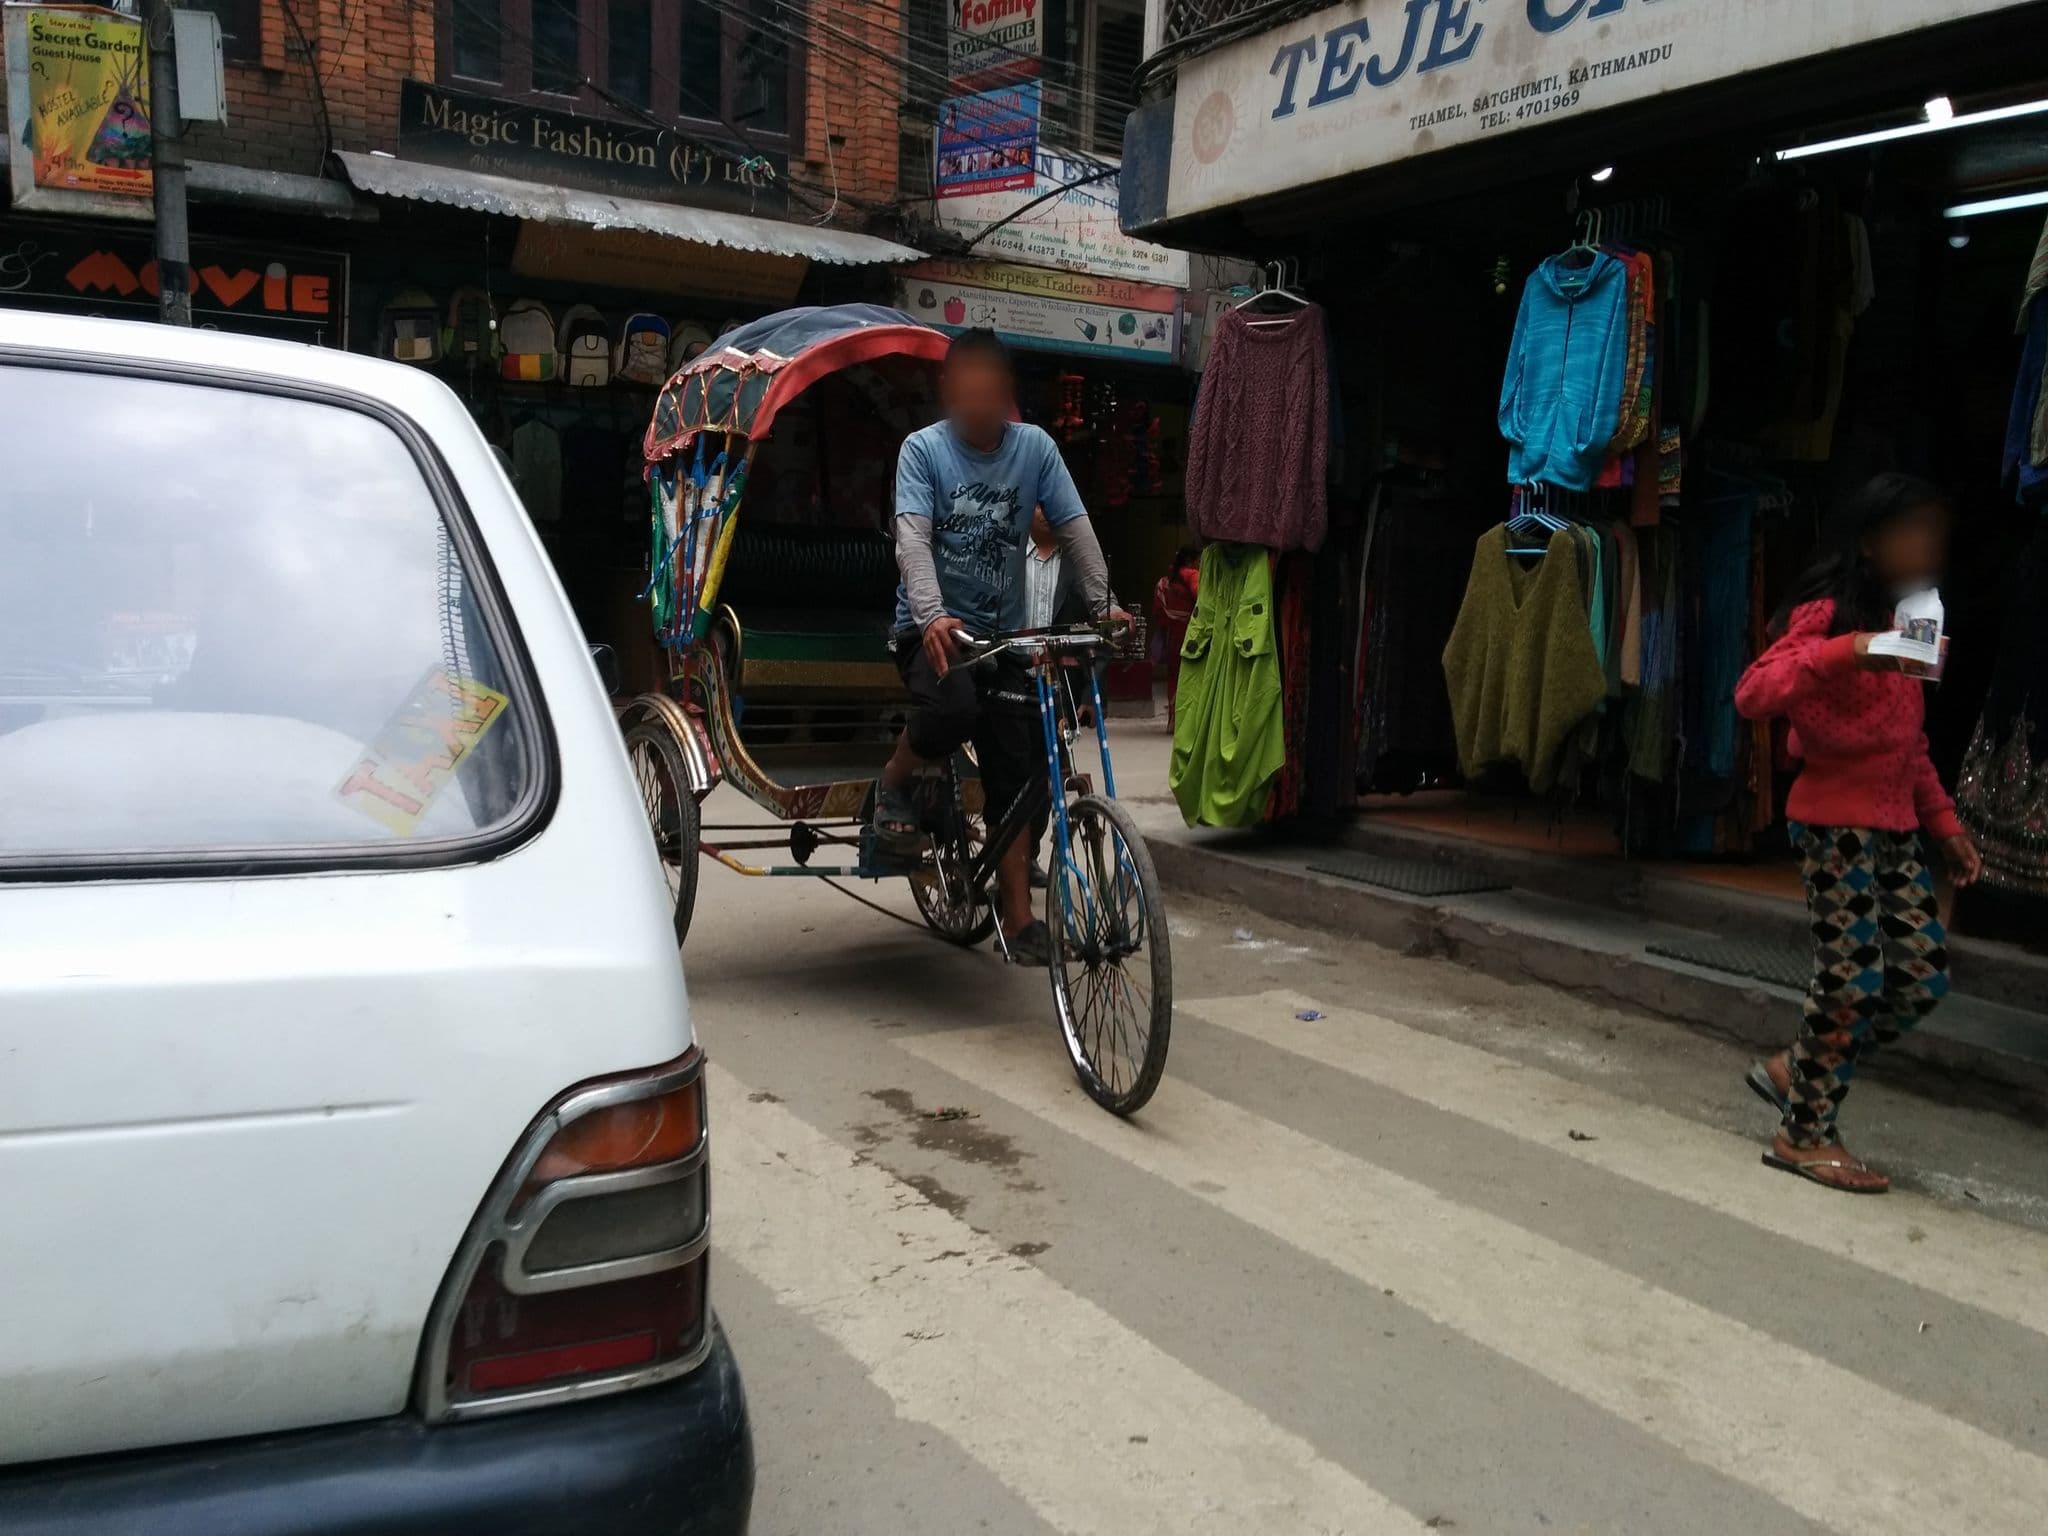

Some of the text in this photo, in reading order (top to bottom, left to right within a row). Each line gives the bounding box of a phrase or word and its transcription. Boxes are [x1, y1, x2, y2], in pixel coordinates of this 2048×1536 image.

[32, 25, 140, 55] Secret Garden
[48, 18, 67, 29] Stay
[78, 22, 92, 31] the
[32, 45, 102, 64] Guest House
[1269, 0, 1485, 121] TEJE
[38, 90, 76, 119] HOSTEL
[1410, 104, 1468, 131] THAMEL,
[1472, 75, 1563, 114] SATGHUMTI,
[1568, 43, 1674, 86] KATHMANDU
[1480, 88, 1581, 131] TEL: 4701969
[421, 95, 519, 148] Magic
[531, 115, 657, 168] Fashion
[983, 264, 1040, 291] Surprise
[1043, 274, 1094, 297] Traders
[340, 672, 500, 816] TAXI
